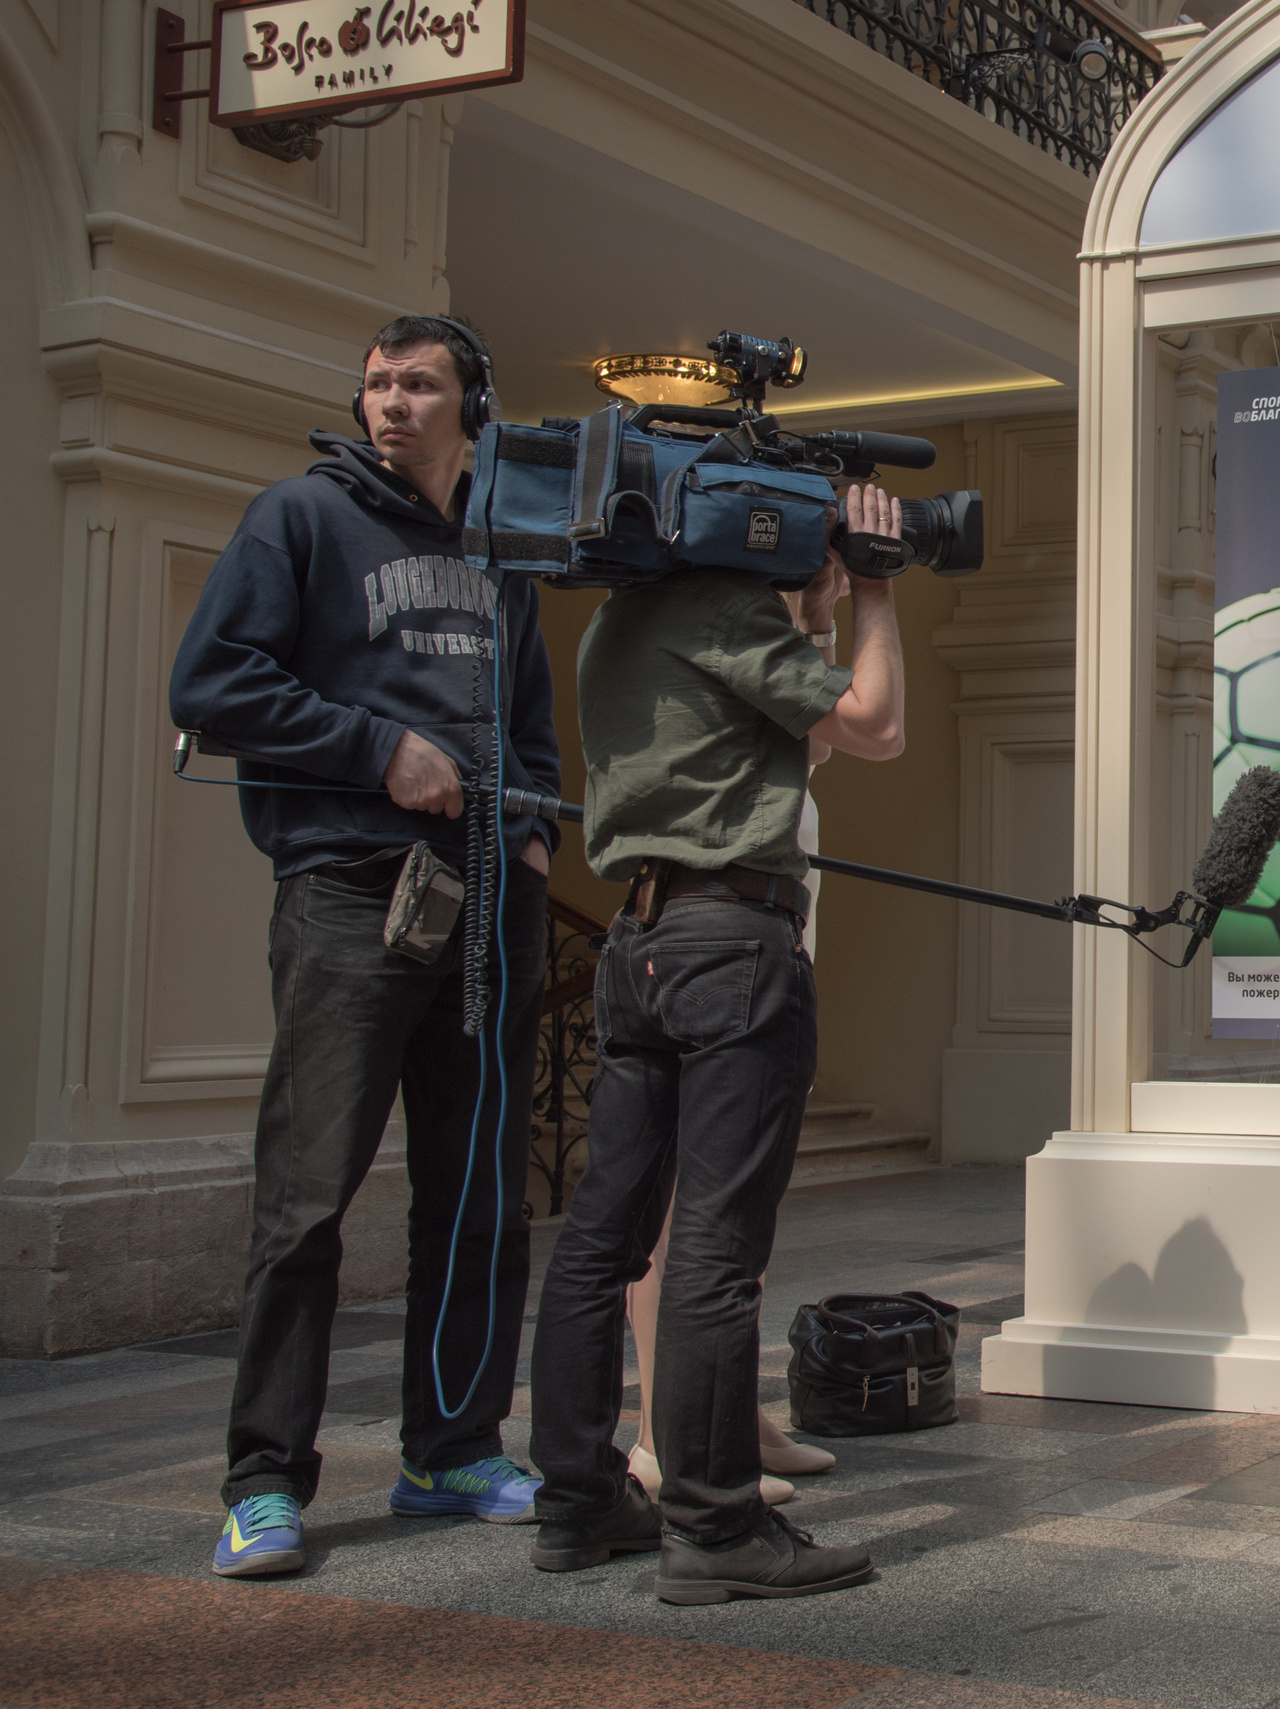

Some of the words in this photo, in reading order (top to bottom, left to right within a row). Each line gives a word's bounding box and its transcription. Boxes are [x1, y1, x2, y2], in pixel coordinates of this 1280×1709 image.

[243, 21, 333, 76] Bosco
[314, 64, 394, 93] FAMILY
[753, 519, 777, 532] porta
[750, 532, 775, 543] brace
[869, 541, 902, 553] FUJINON
[1227, 971, 1245, 983] Вы
